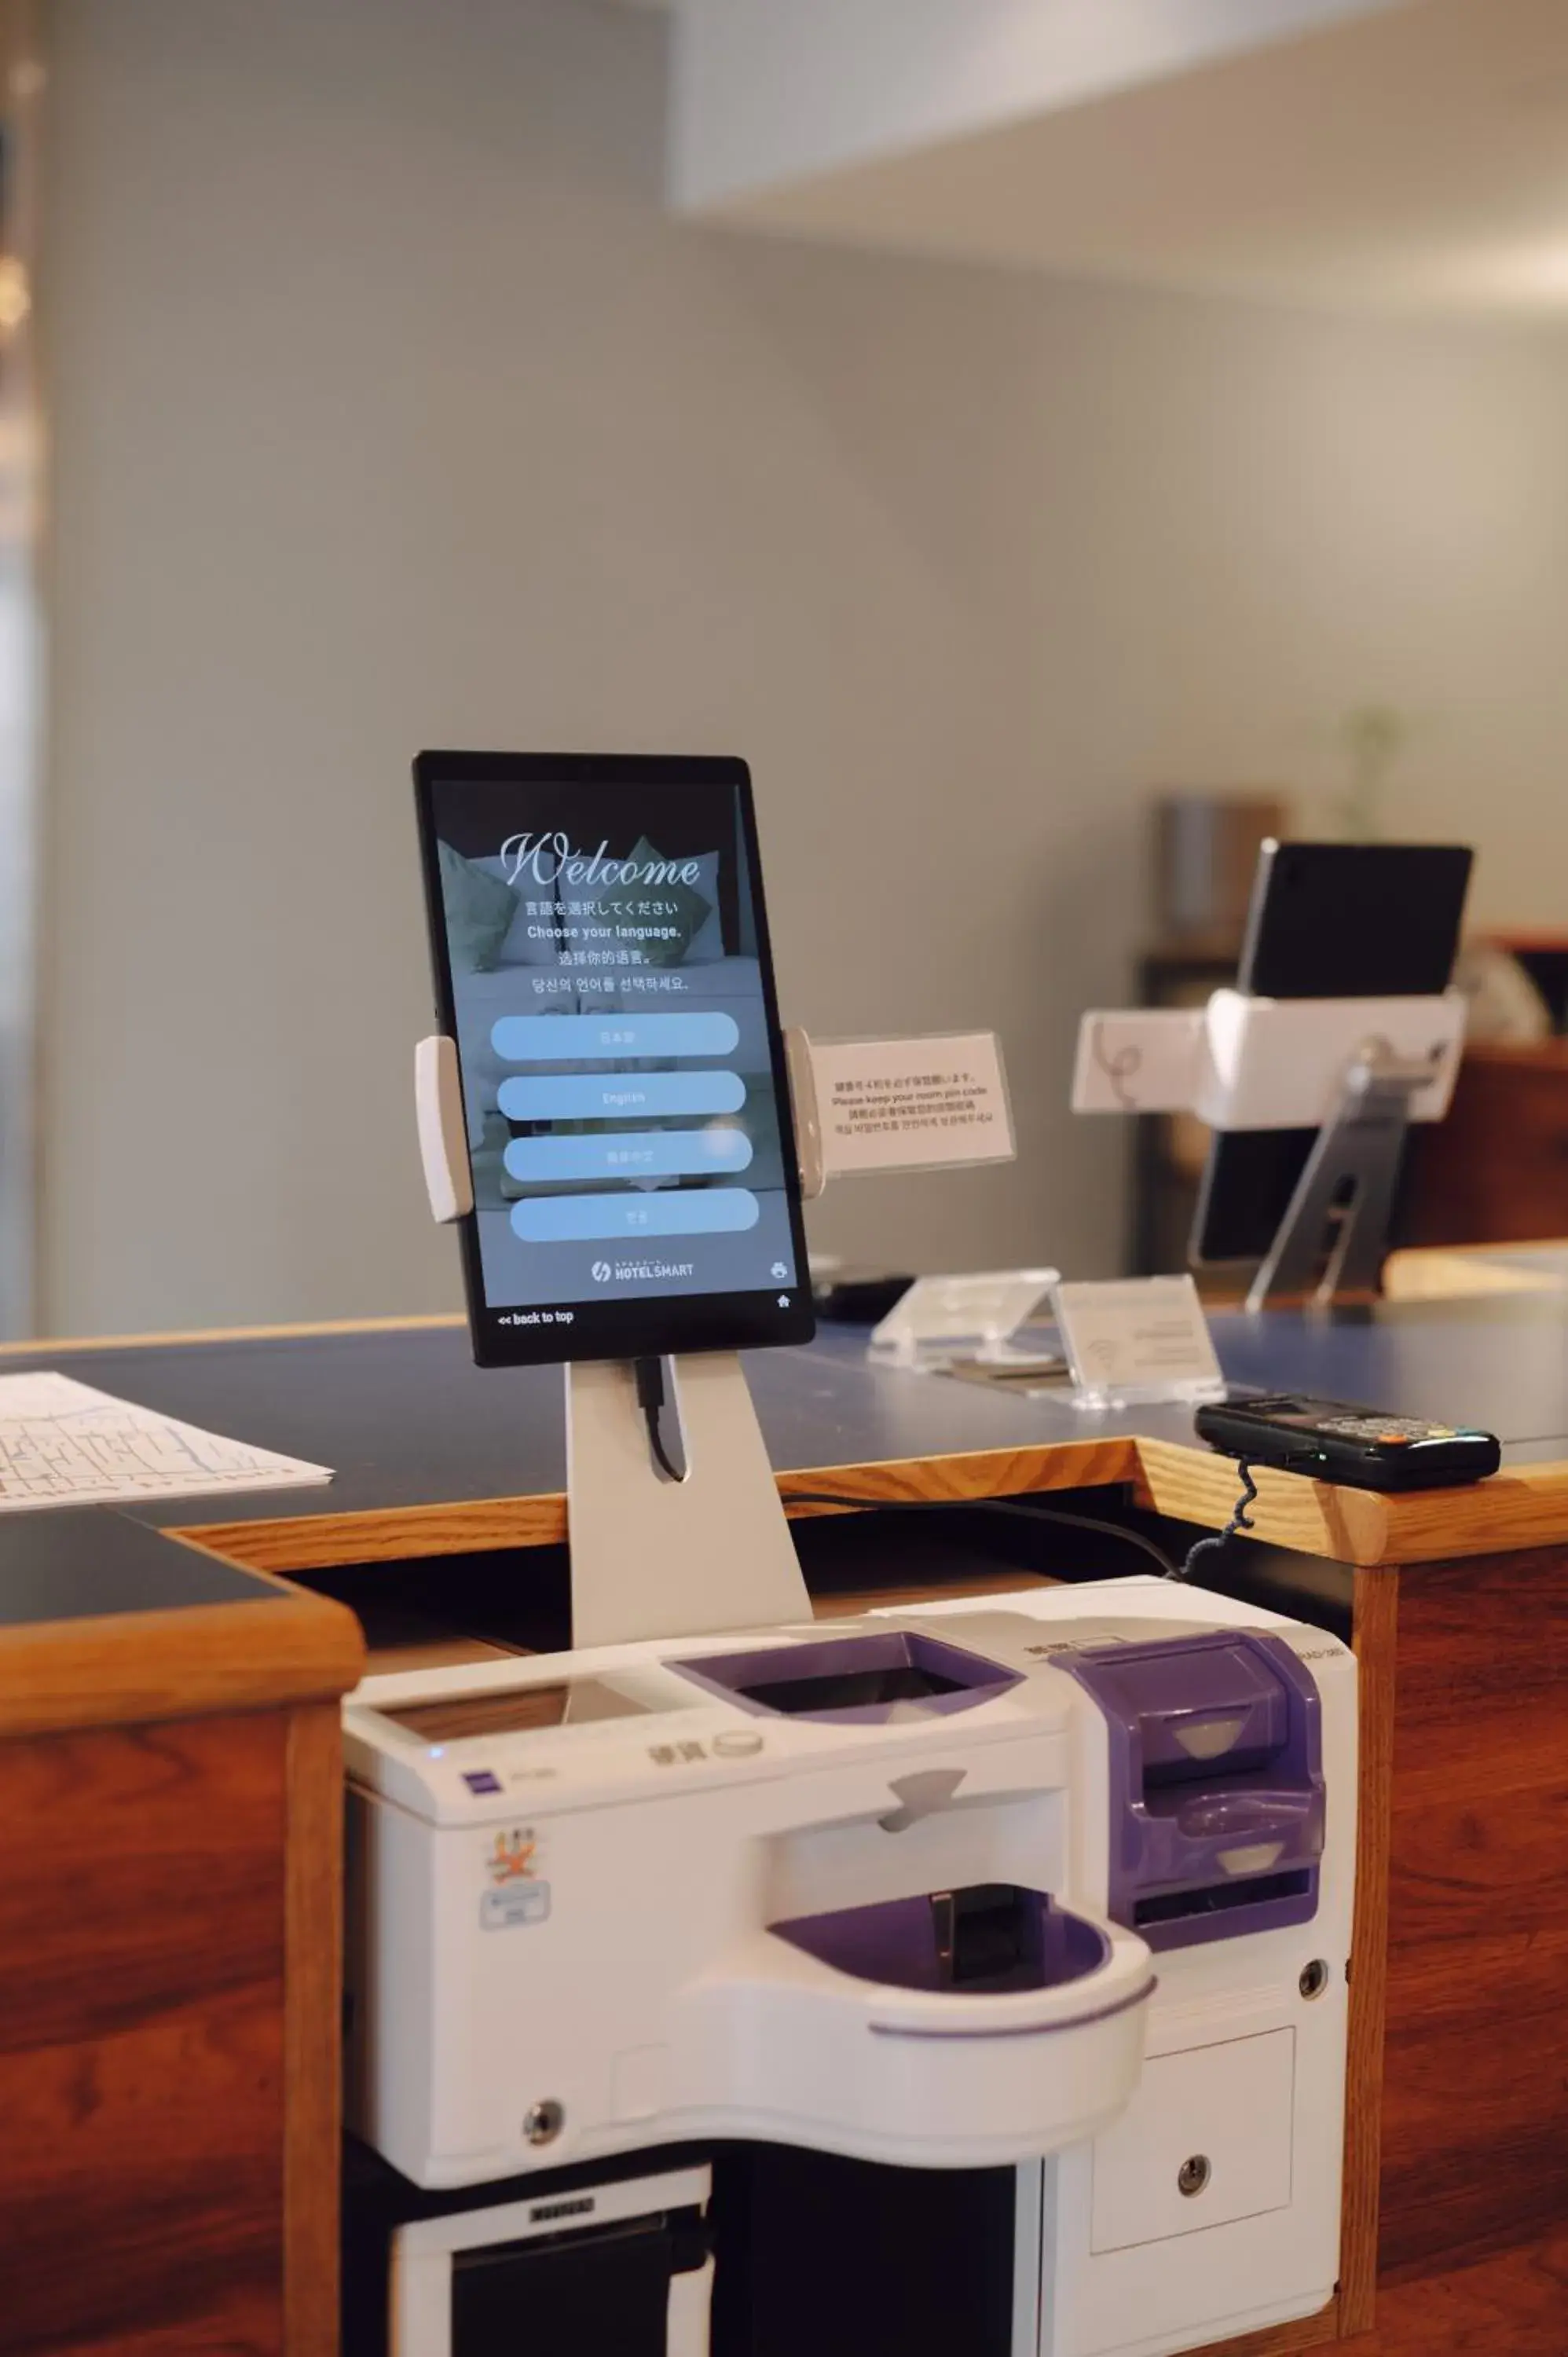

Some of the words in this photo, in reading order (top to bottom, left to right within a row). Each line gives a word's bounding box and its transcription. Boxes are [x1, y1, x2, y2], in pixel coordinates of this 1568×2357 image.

[500, 832, 700, 885] Welcome
[526, 901, 678, 917] 言語を選択してください
[527, 926, 578, 939] Choose
[582, 927, 611, 940] your
[616, 926, 682, 940] language.
[513, 1312, 540, 1325] back
[542, 1312, 553, 1323] to
[555, 1310, 573, 1324] top
